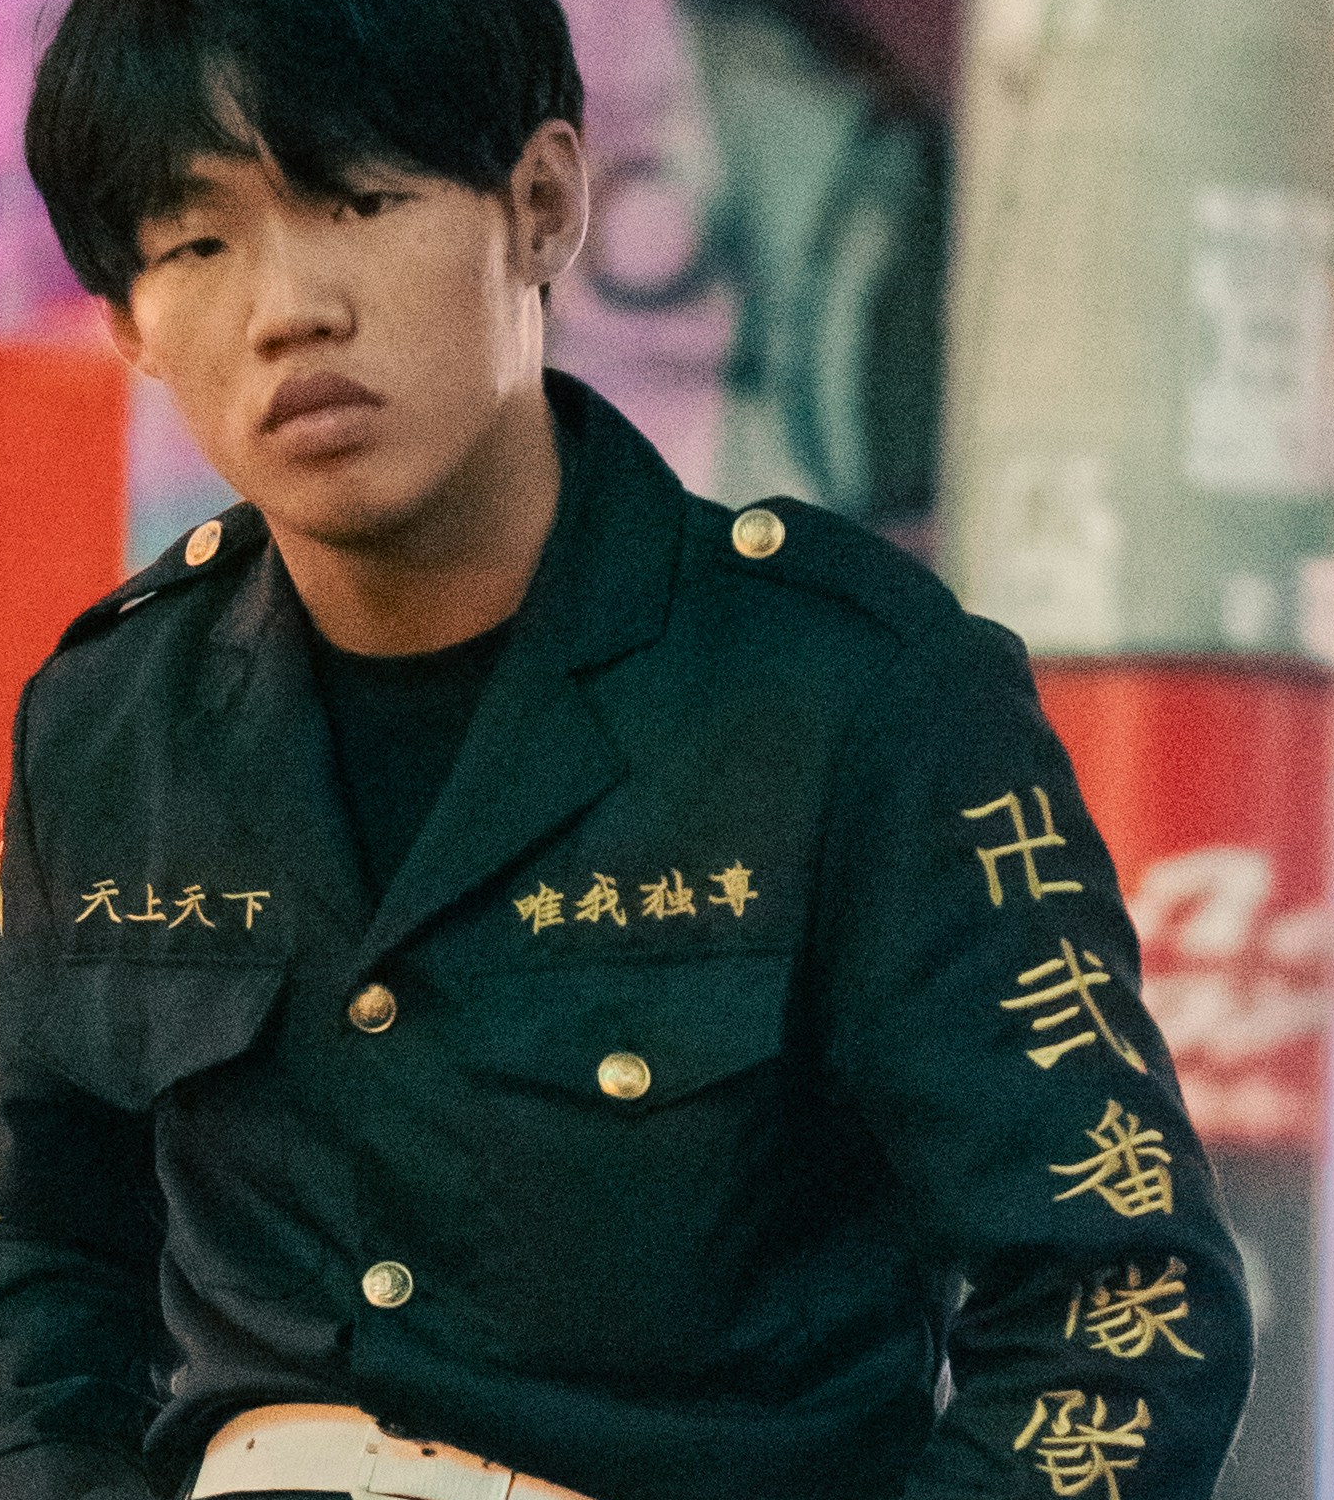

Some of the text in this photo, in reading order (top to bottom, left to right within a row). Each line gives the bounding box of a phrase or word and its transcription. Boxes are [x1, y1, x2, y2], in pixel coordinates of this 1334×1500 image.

[73, 878, 273, 931] 天上天下
[512, 859, 760, 936] 唯我独尊
